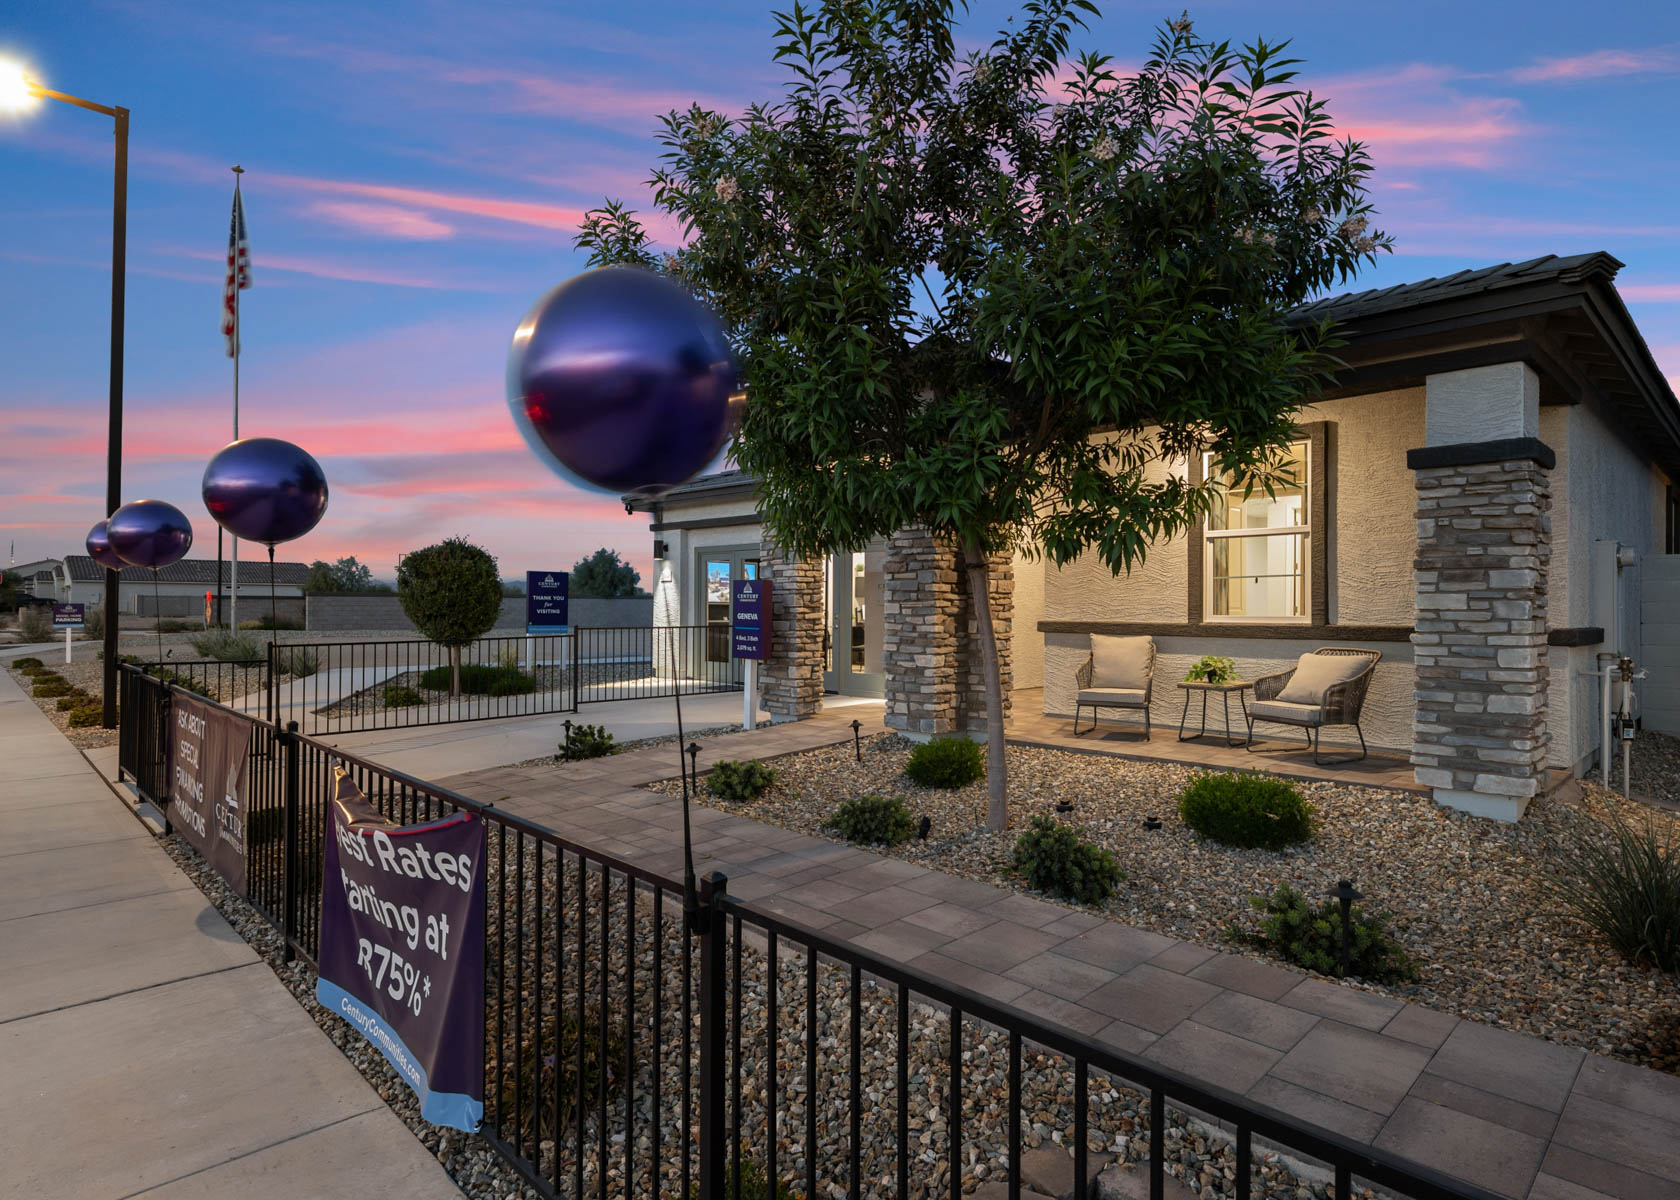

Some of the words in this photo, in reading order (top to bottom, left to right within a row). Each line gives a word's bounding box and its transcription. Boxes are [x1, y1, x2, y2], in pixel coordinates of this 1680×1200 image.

[737, 612, 758, 620] GENEVA
[178, 709, 188, 730] ASK
[188, 713, 206, 740] ABOUT
[215, 803, 242, 839] CENTUR
[373, 830, 472, 892] Rates
[425, 912, 450, 960] at
[341, 998, 420, 1087] CenturyCommunities.com
